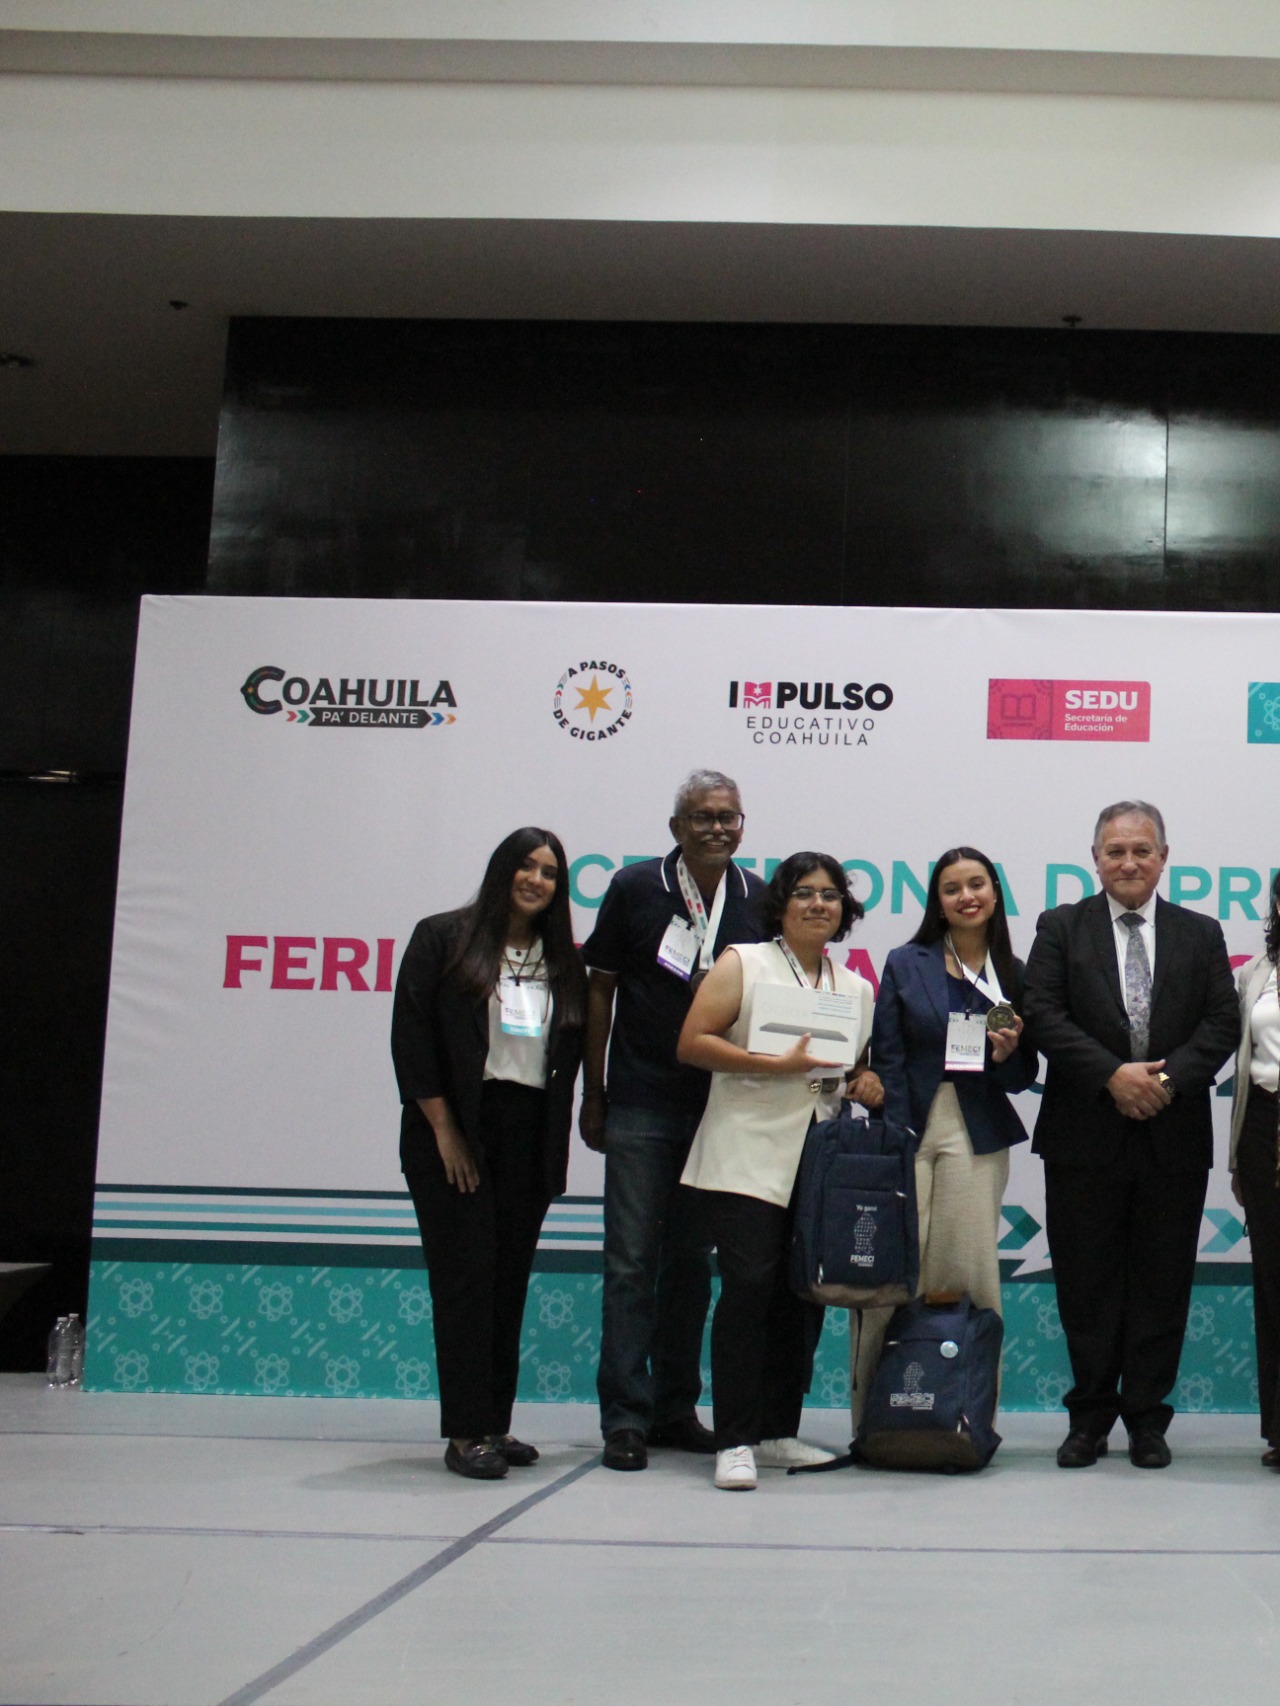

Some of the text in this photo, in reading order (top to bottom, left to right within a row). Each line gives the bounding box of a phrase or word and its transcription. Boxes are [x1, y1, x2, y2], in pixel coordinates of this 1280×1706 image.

[568, 660, 626, 679] A PASOS
[240, 665, 457, 715] COAHUILA
[729, 681, 893, 711] IMPULSO
[1065, 690, 1138, 710] SEDU
[349, 711, 418, 725] DELANTE
[553, 709, 632, 741] DE GIGANTE
[746, 716, 875, 731] EDUCATIVO
[1065, 713, 1128, 723] Secretaría de
[1064, 722, 1114, 732] Educación
[753, 731, 868, 746] COAHUILA
[850, 1254, 875, 1263] FEMECI
